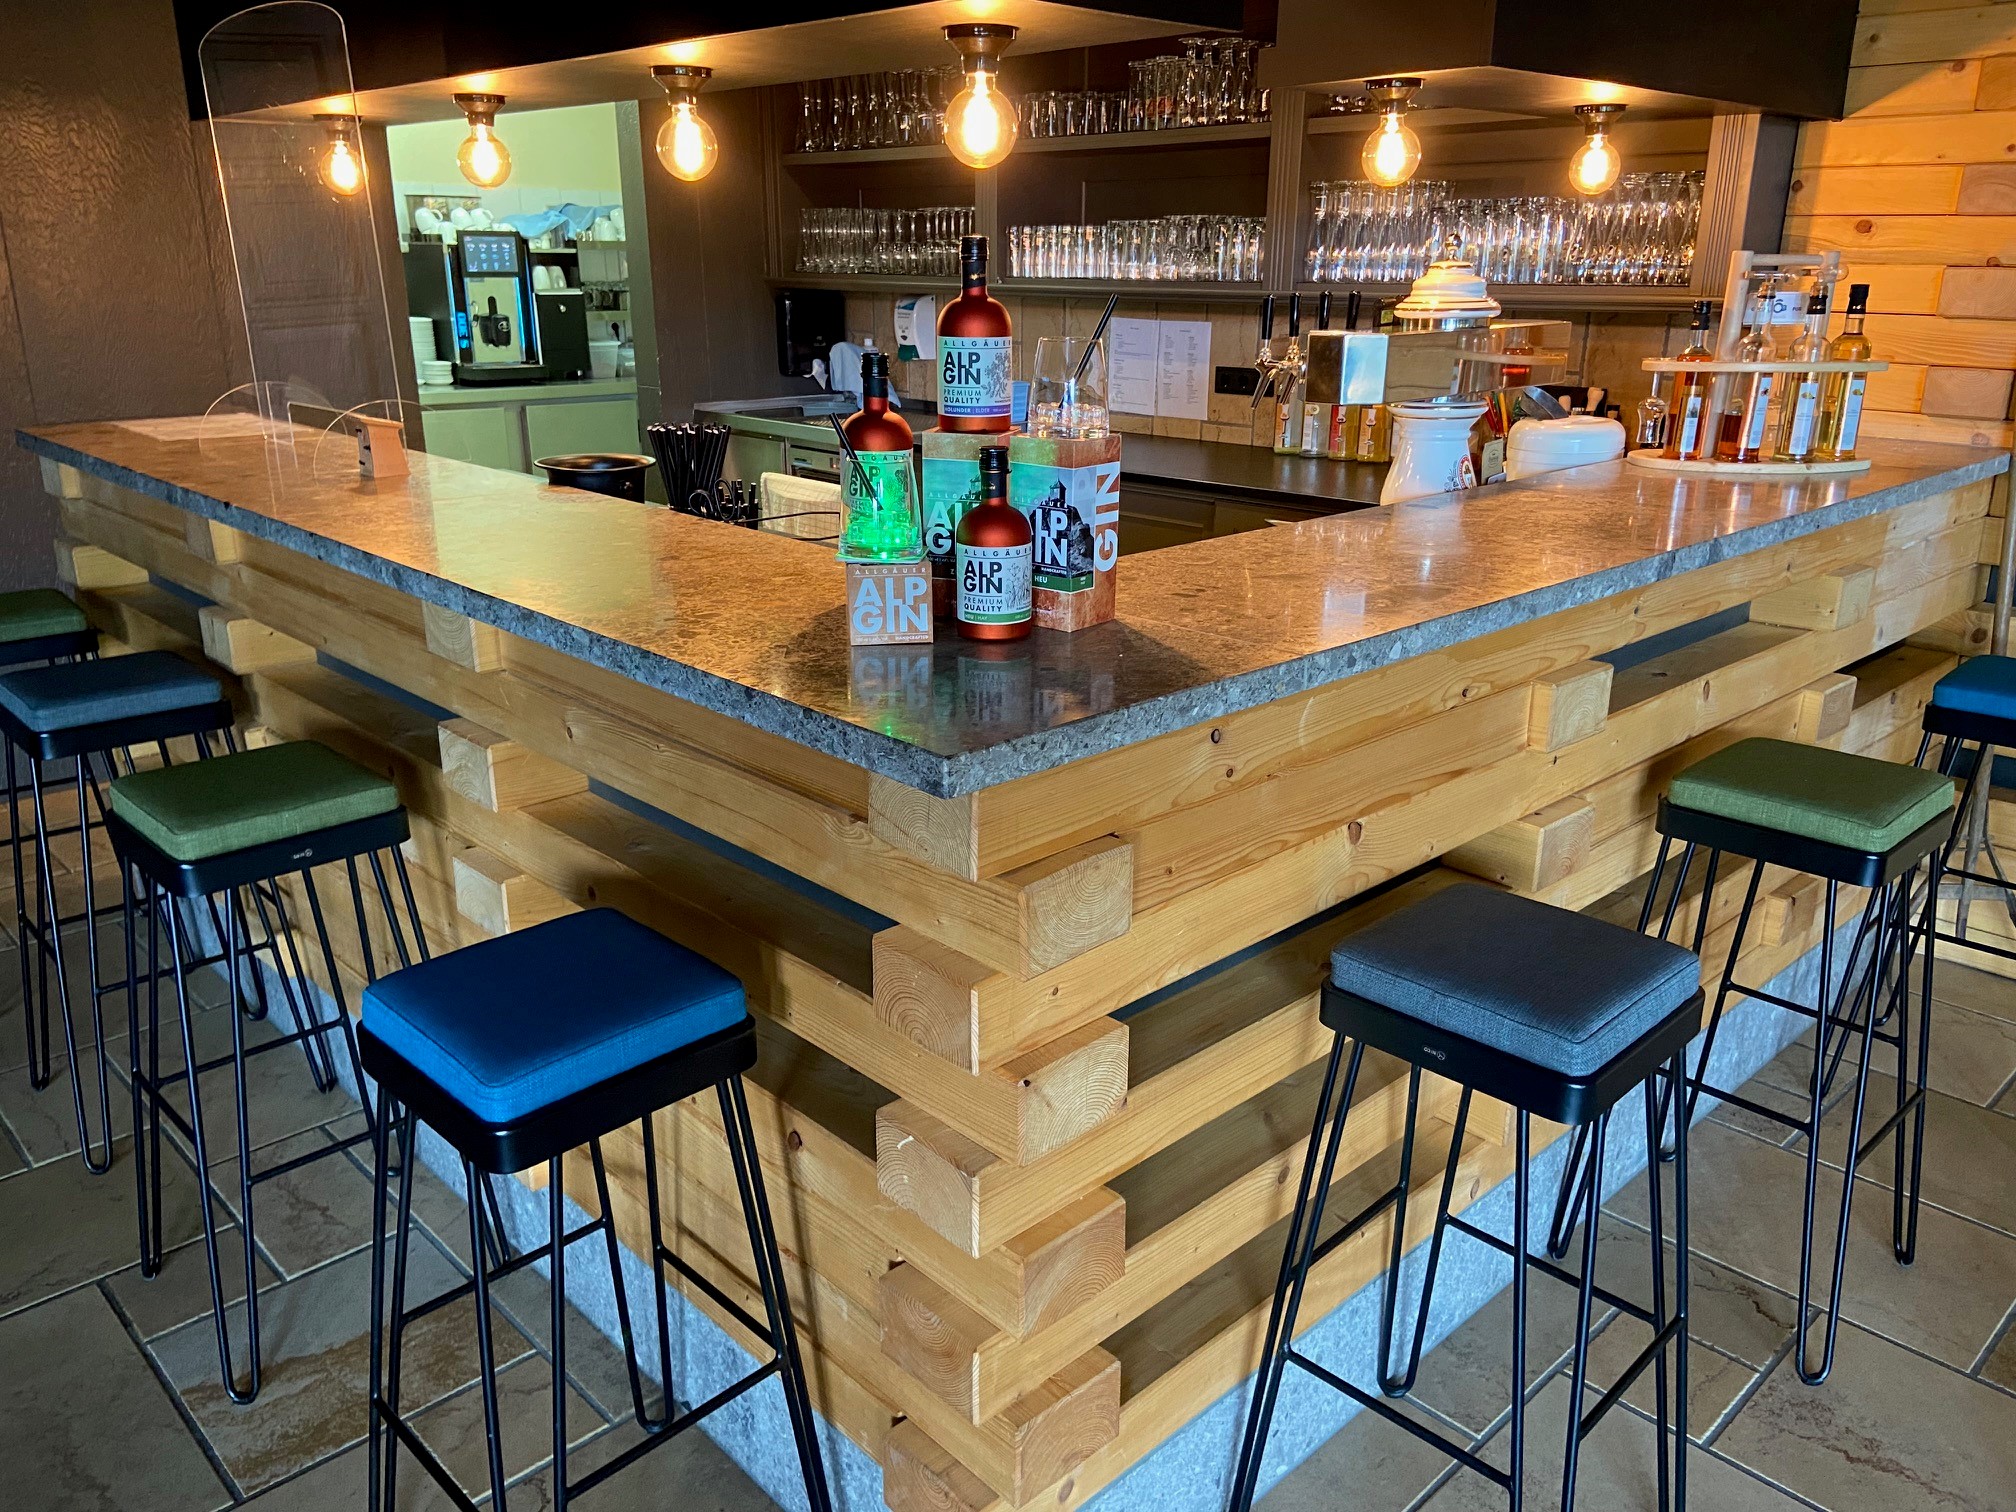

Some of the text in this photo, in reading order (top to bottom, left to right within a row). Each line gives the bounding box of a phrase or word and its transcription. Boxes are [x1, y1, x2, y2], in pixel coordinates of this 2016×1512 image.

[944, 351, 981, 368] ALP
[943, 367, 981, 385] GIN
[944, 396, 981, 404] QUALITY
[1095, 461, 1120, 572] GIN
[855, 567, 926, 575] ALLGÄUER
[964, 560, 1003, 577] ALP
[963, 575, 1003, 593] GIN
[1034, 575, 1048, 583] HEU
[854, 577, 928, 607] ALP
[964, 596, 1003, 605] PREMIUM
[964, 603, 1003, 612] QUALITY
[852, 604, 929, 634] GIN
